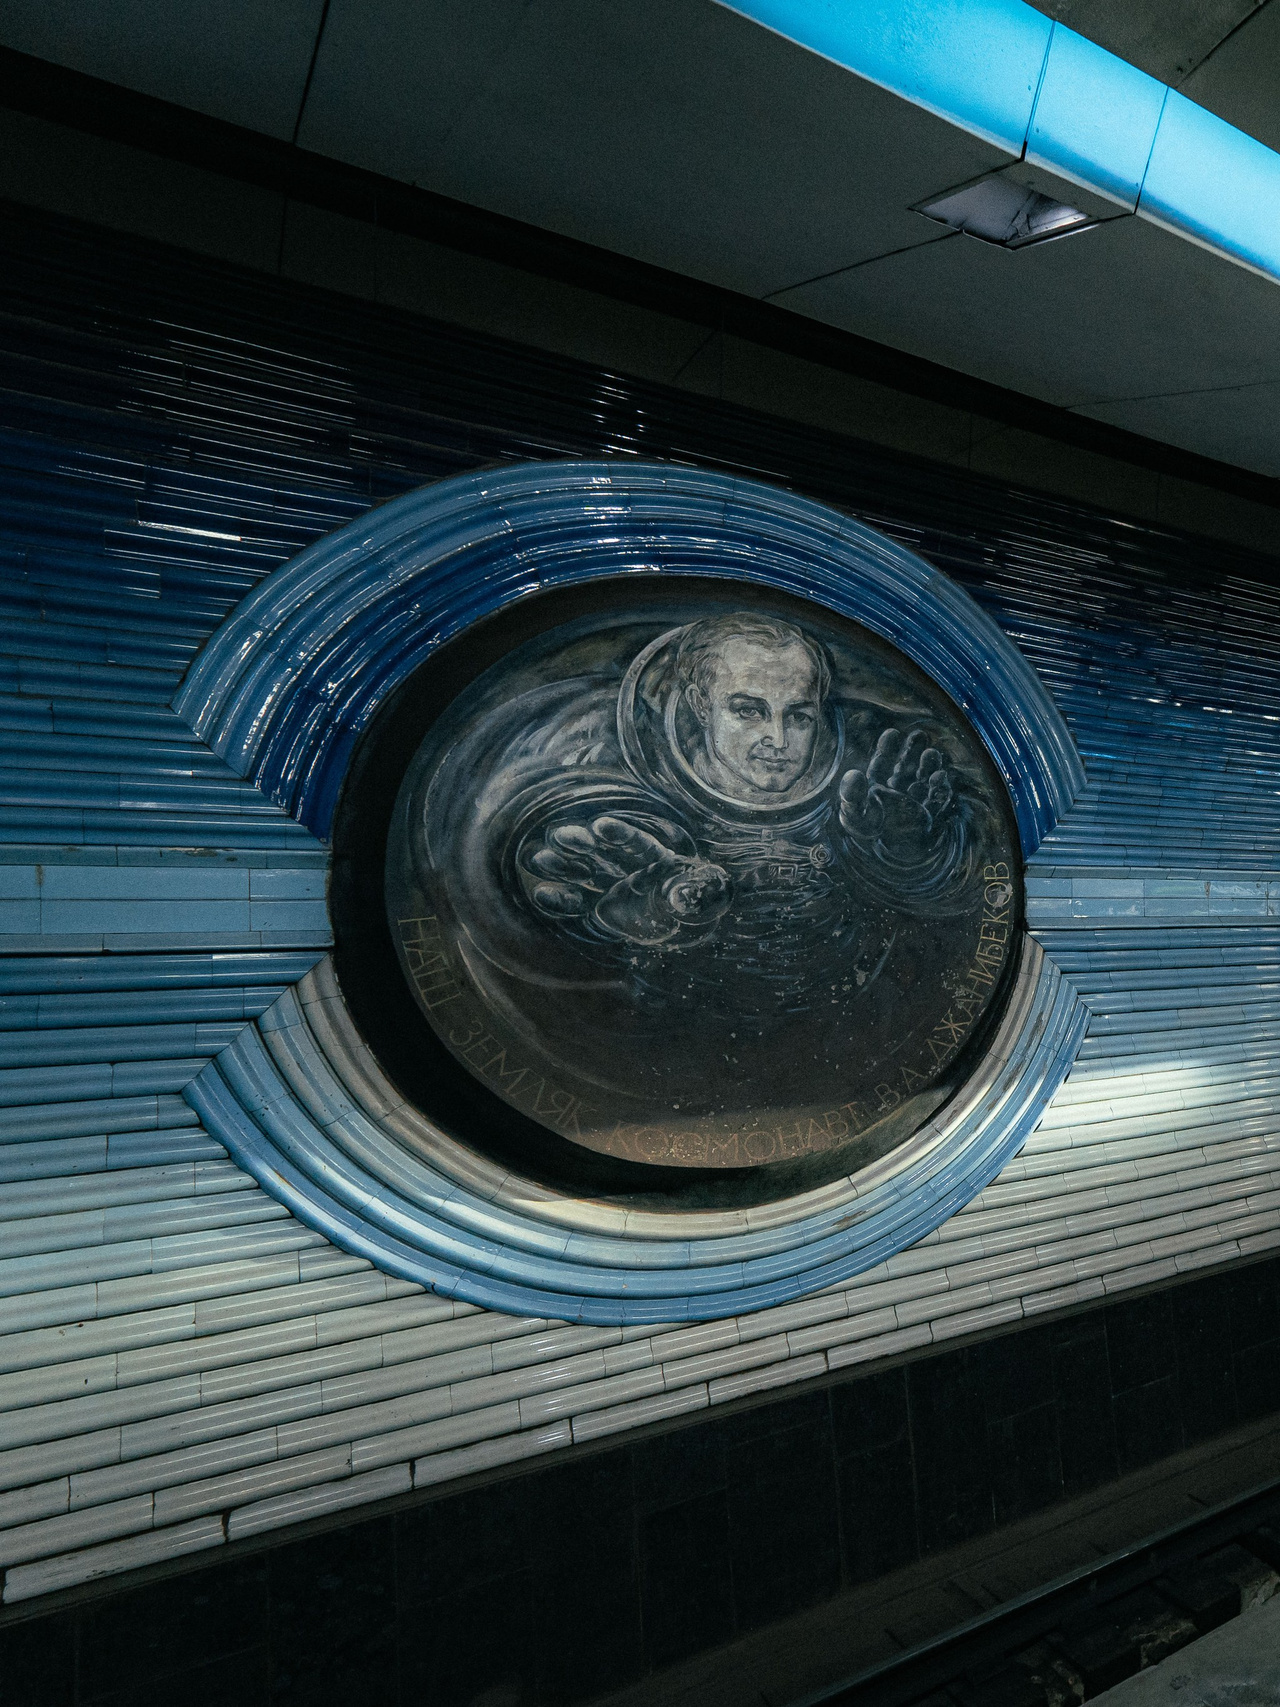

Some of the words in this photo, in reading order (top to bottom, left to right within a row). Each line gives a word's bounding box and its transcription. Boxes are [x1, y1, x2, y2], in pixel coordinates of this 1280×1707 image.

[449, 1019, 597, 1139] ЗЕМЛЯК
[606, 1101, 861, 1163] КОСМОНАВТ
[925, 861, 1011, 1066] ДЖАНИБЕКОВ
